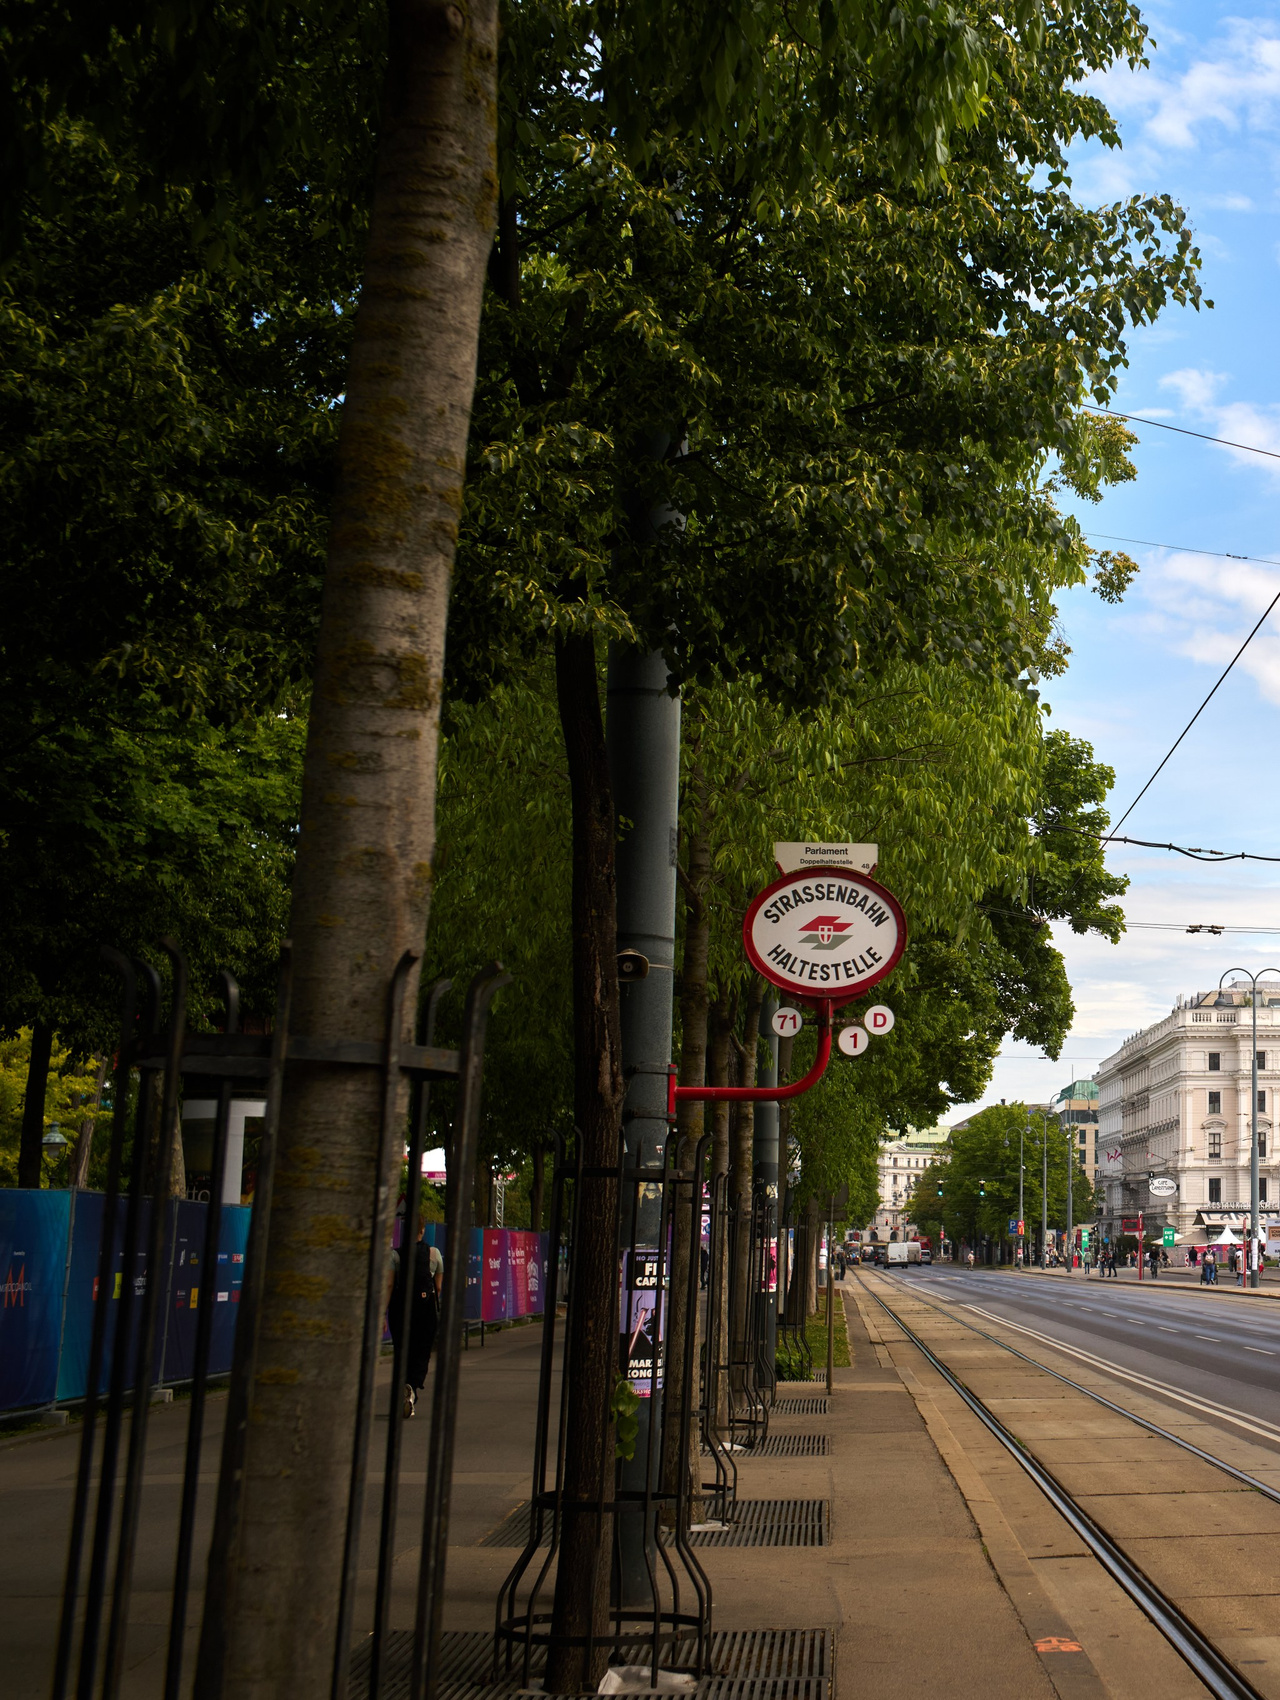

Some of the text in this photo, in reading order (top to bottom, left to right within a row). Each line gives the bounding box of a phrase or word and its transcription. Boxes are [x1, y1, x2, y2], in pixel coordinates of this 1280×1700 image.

[805, 847, 848, 856] Parlament
[800, 858, 853, 866] Doppelhaltestelle
[763, 883, 890, 928] STRASSENBAHN
[767, 944, 883, 982] HALTESTELLE
[777, 1014, 797, 1030] 71
[873, 1013, 887, 1028] D
[849, 1032, 858, 1049] 1
